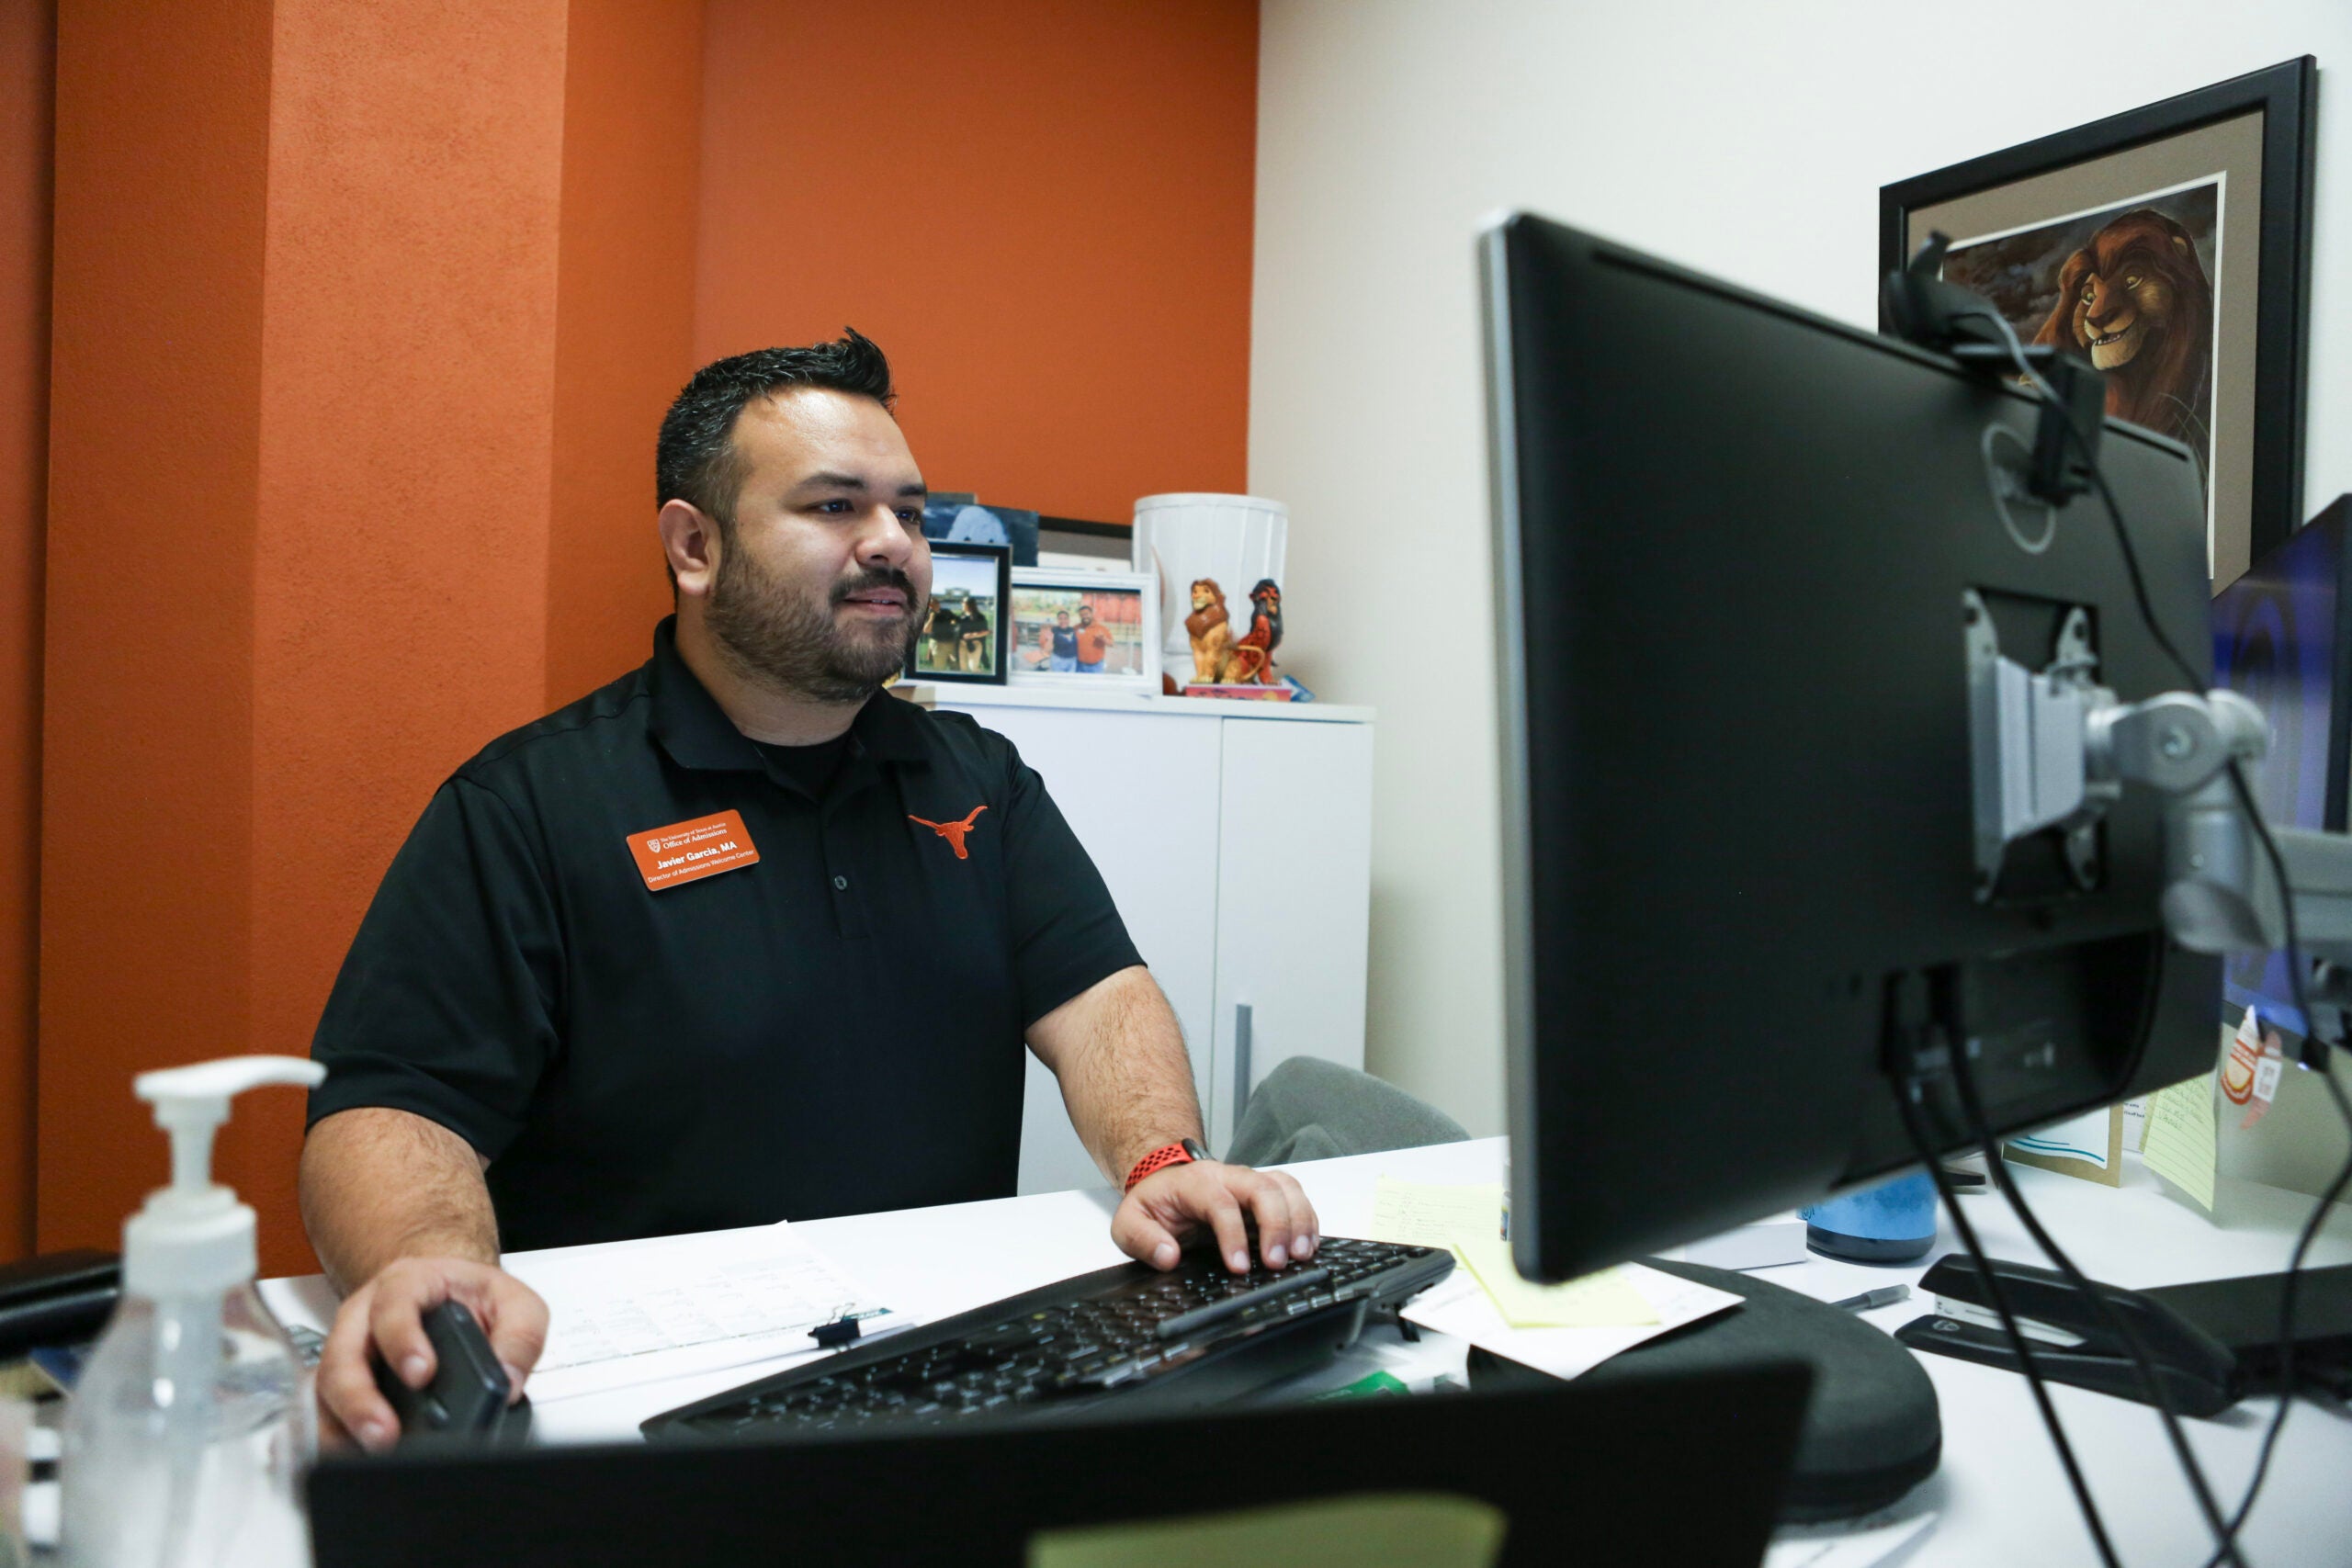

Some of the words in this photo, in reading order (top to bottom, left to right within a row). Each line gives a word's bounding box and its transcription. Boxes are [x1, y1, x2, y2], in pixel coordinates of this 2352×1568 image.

[663, 840, 683, 849] Office
[692, 829, 727, 841] Admissions
[648, 873, 671, 883] Director
[679, 863, 710, 874] Admissions
[711, 856, 735, 866] Welcome
[736, 849, 754, 859] Center
[657, 856, 685, 869] Javier
[687, 846, 720, 861] Garcia,
[720, 841, 737, 852] MA
